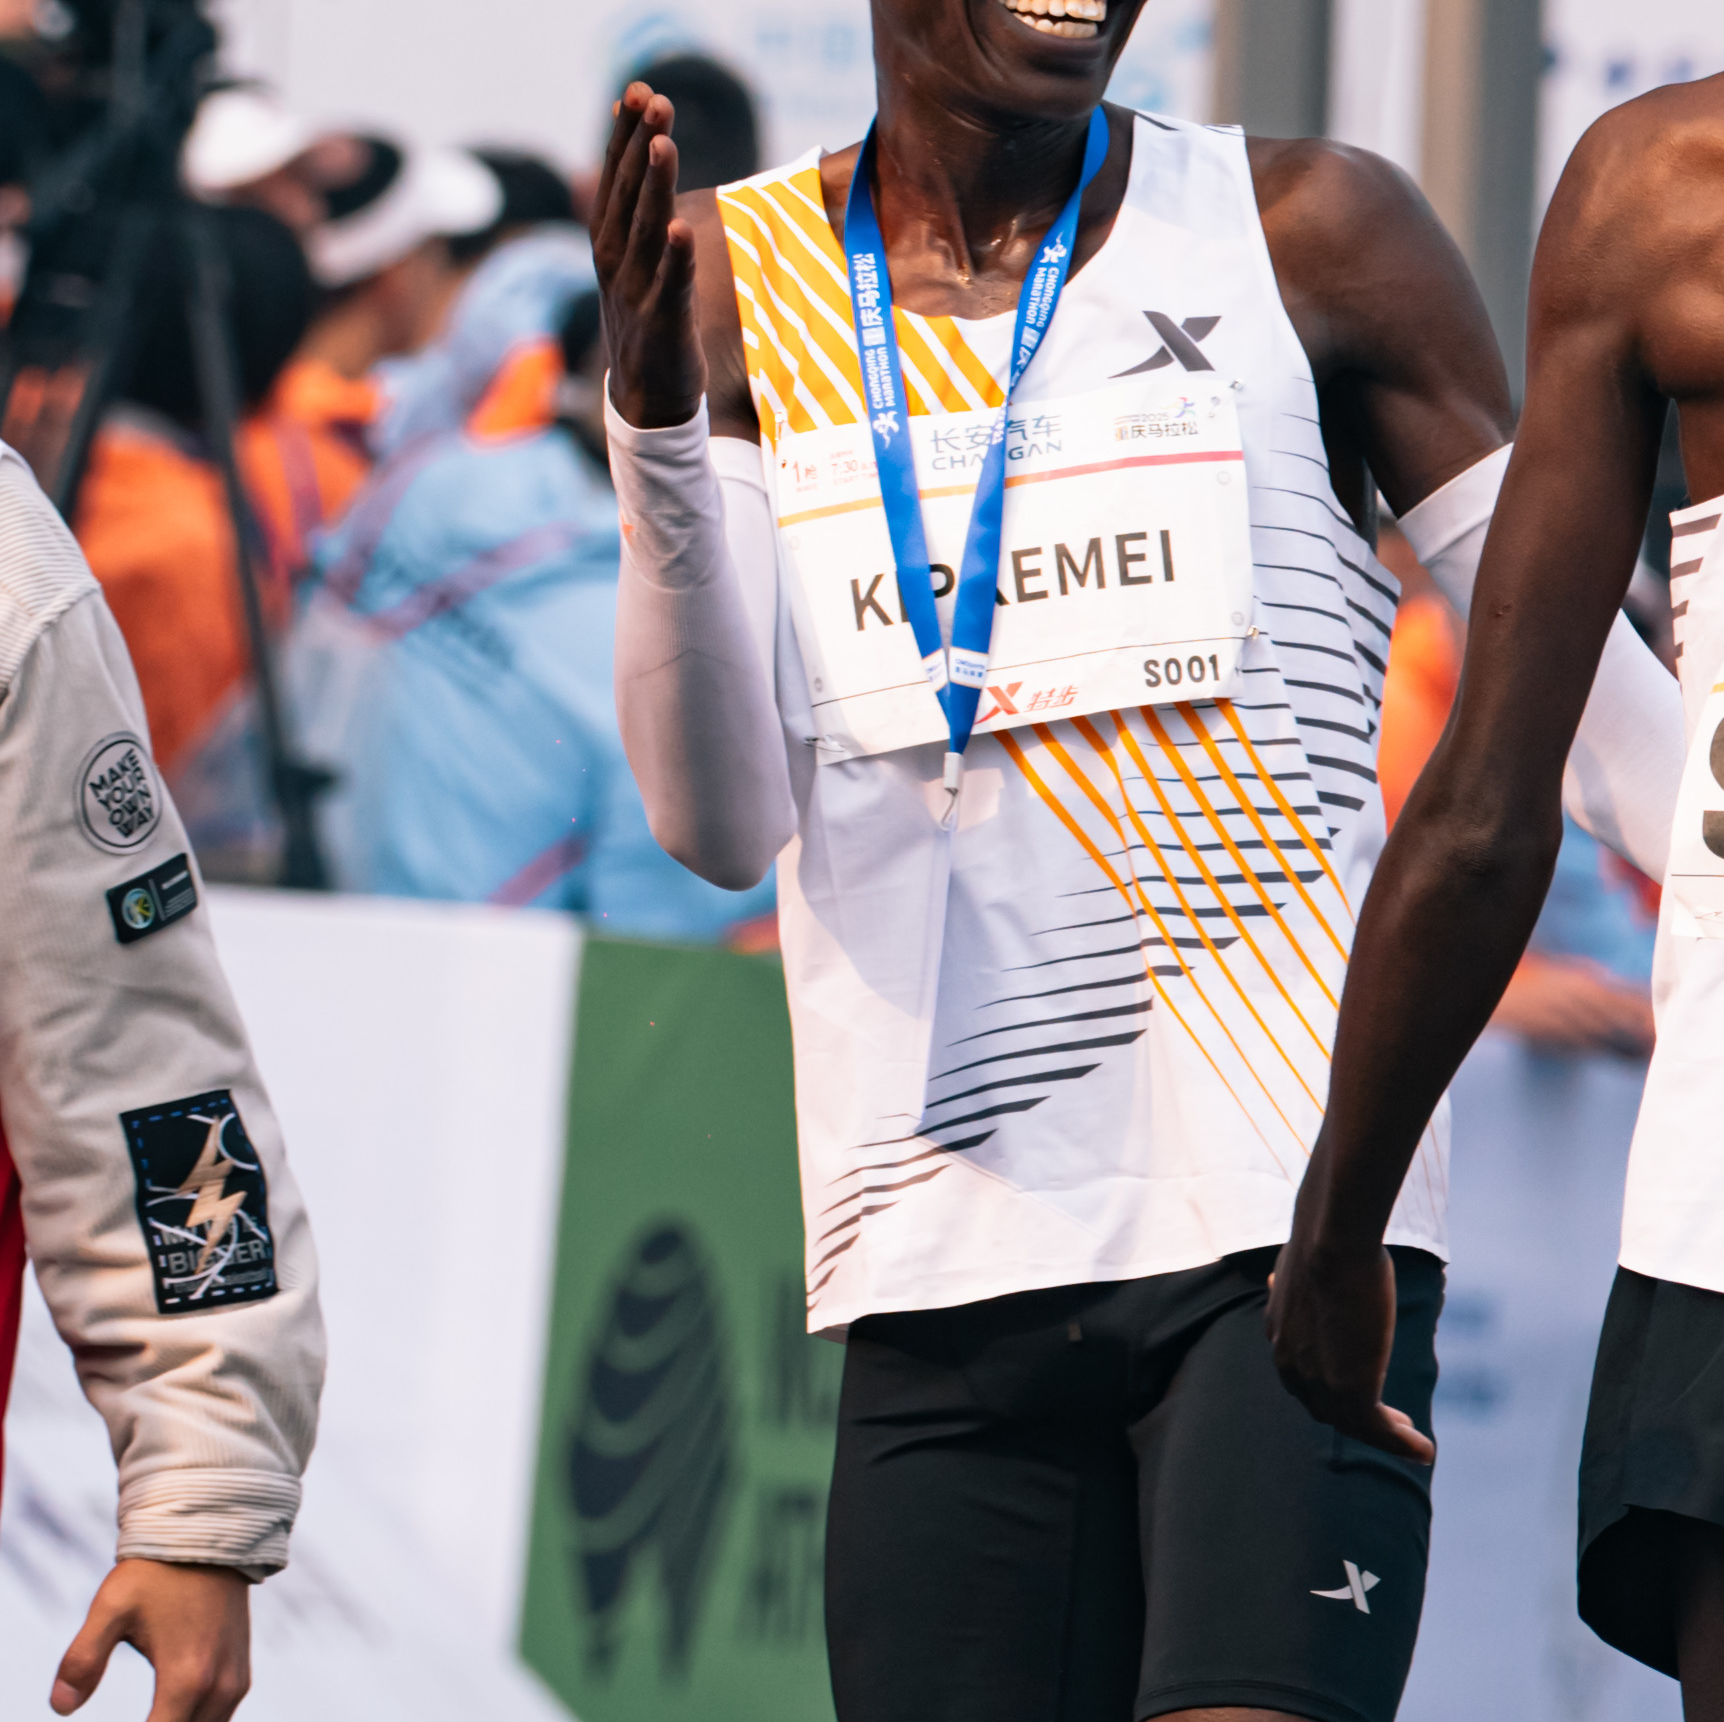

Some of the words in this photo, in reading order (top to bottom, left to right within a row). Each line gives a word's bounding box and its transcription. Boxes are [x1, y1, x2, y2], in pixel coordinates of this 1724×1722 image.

[932, 440, 1062, 470] CHAGAN
[1144, 654, 1219, 688] S001
[1024, 685, 1079, 712] 特步
[89, 748, 139, 798] MAKE
[98, 766, 147, 812] YOUR
[108, 788, 153, 826] OWN
[116, 805, 155, 839] WAY
